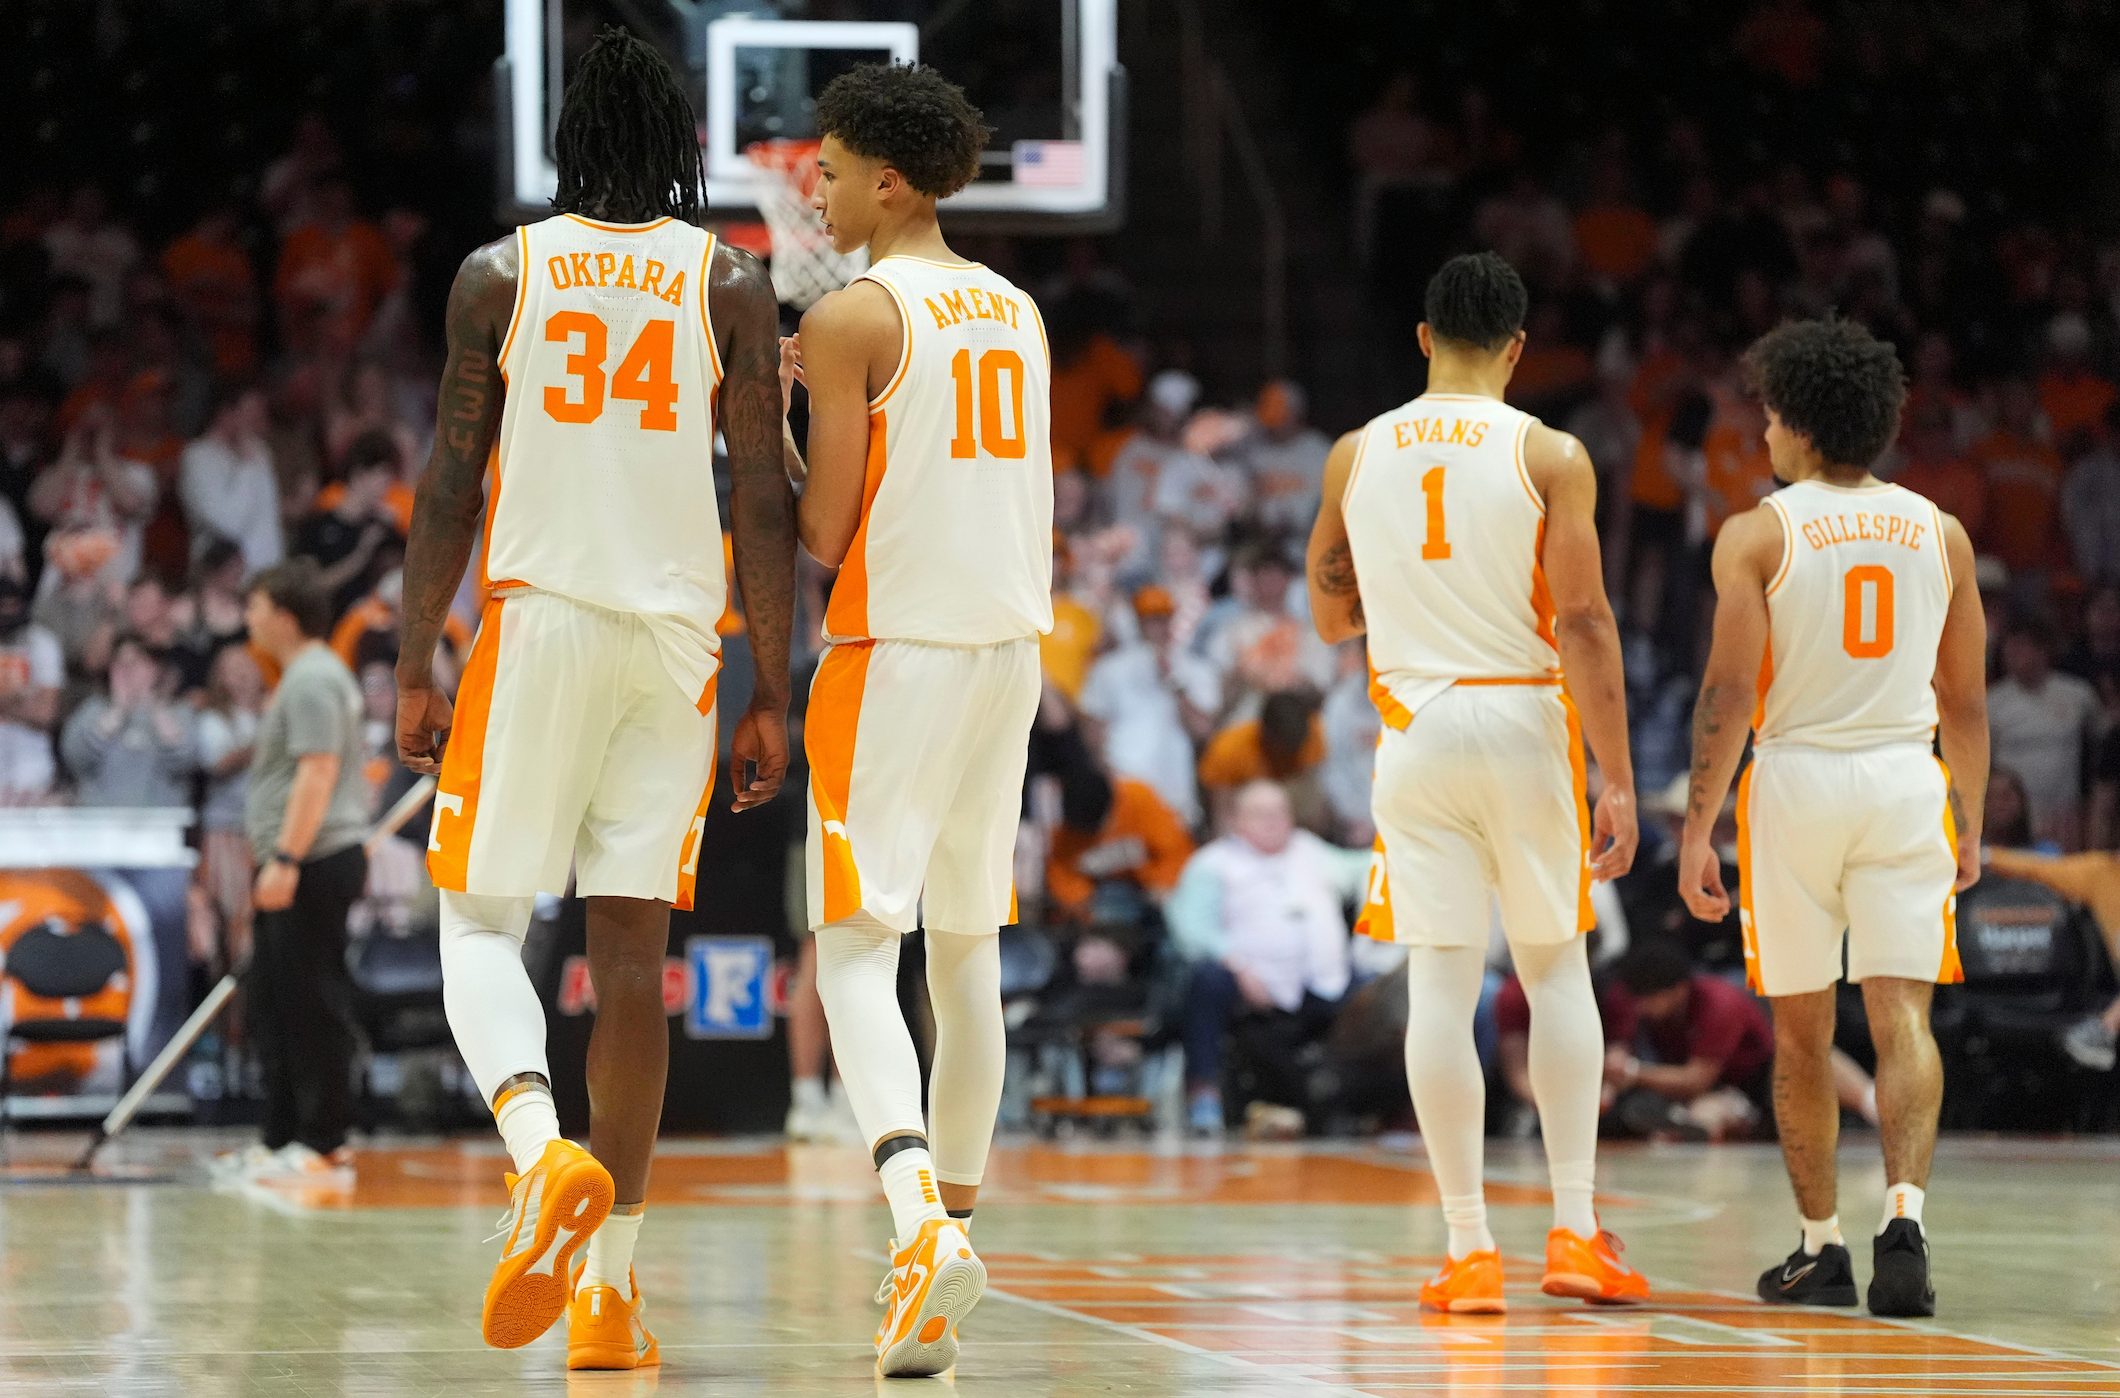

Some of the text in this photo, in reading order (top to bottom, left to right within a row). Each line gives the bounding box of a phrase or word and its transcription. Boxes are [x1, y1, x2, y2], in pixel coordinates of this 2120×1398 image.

[547, 252, 686, 307] OKPARA
[923, 287, 1020, 331] AMENT
[543, 310, 679, 432] 34
[951, 348, 1026, 459] 10
[1393, 418, 1490, 449] EVANS
[1421, 466, 1451, 561] 1
[1801, 512, 1925, 551] GILLESPIE
[1842, 564, 1894, 659] 0
